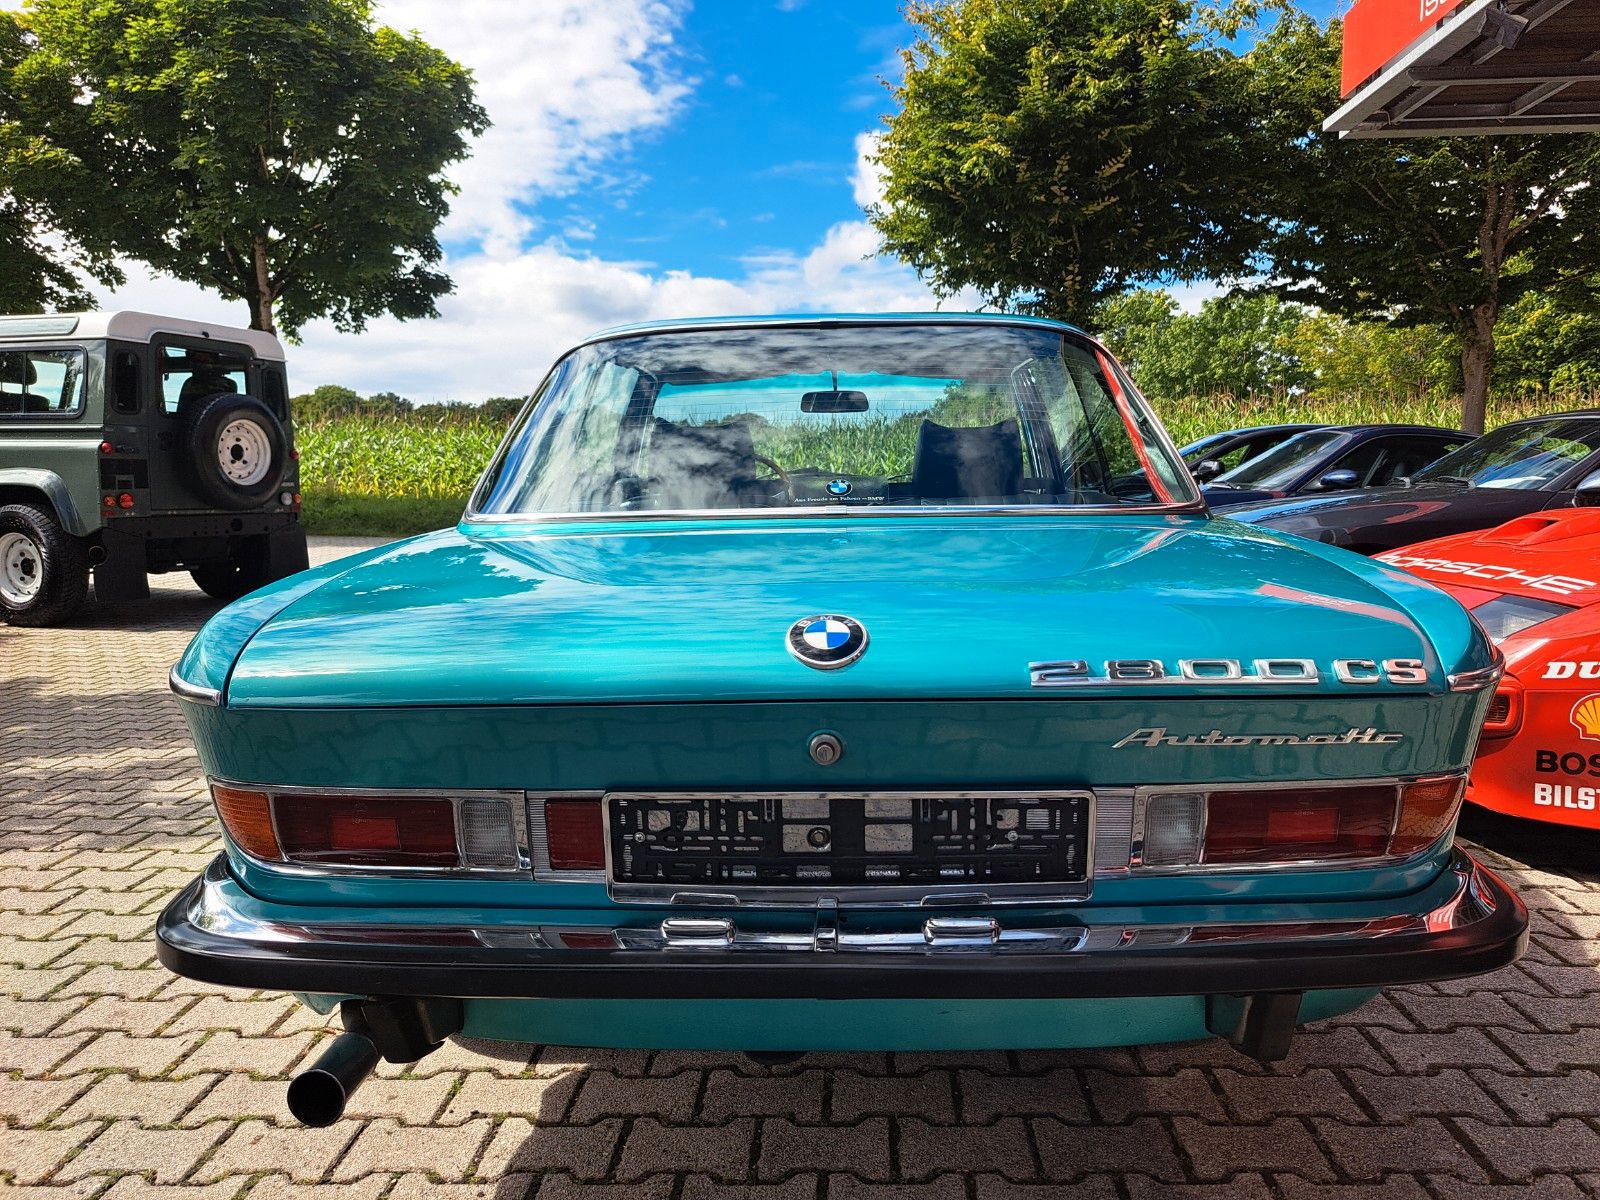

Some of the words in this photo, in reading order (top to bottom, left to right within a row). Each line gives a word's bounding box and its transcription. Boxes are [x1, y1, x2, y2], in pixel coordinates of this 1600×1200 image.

[1028, 658, 1319, 687] 2800
[1333, 659, 1428, 685] CS
[1541, 661, 1600, 679] DU
[1111, 726, 1404, 749] Automatic
[1534, 783, 1600, 810] BILS
